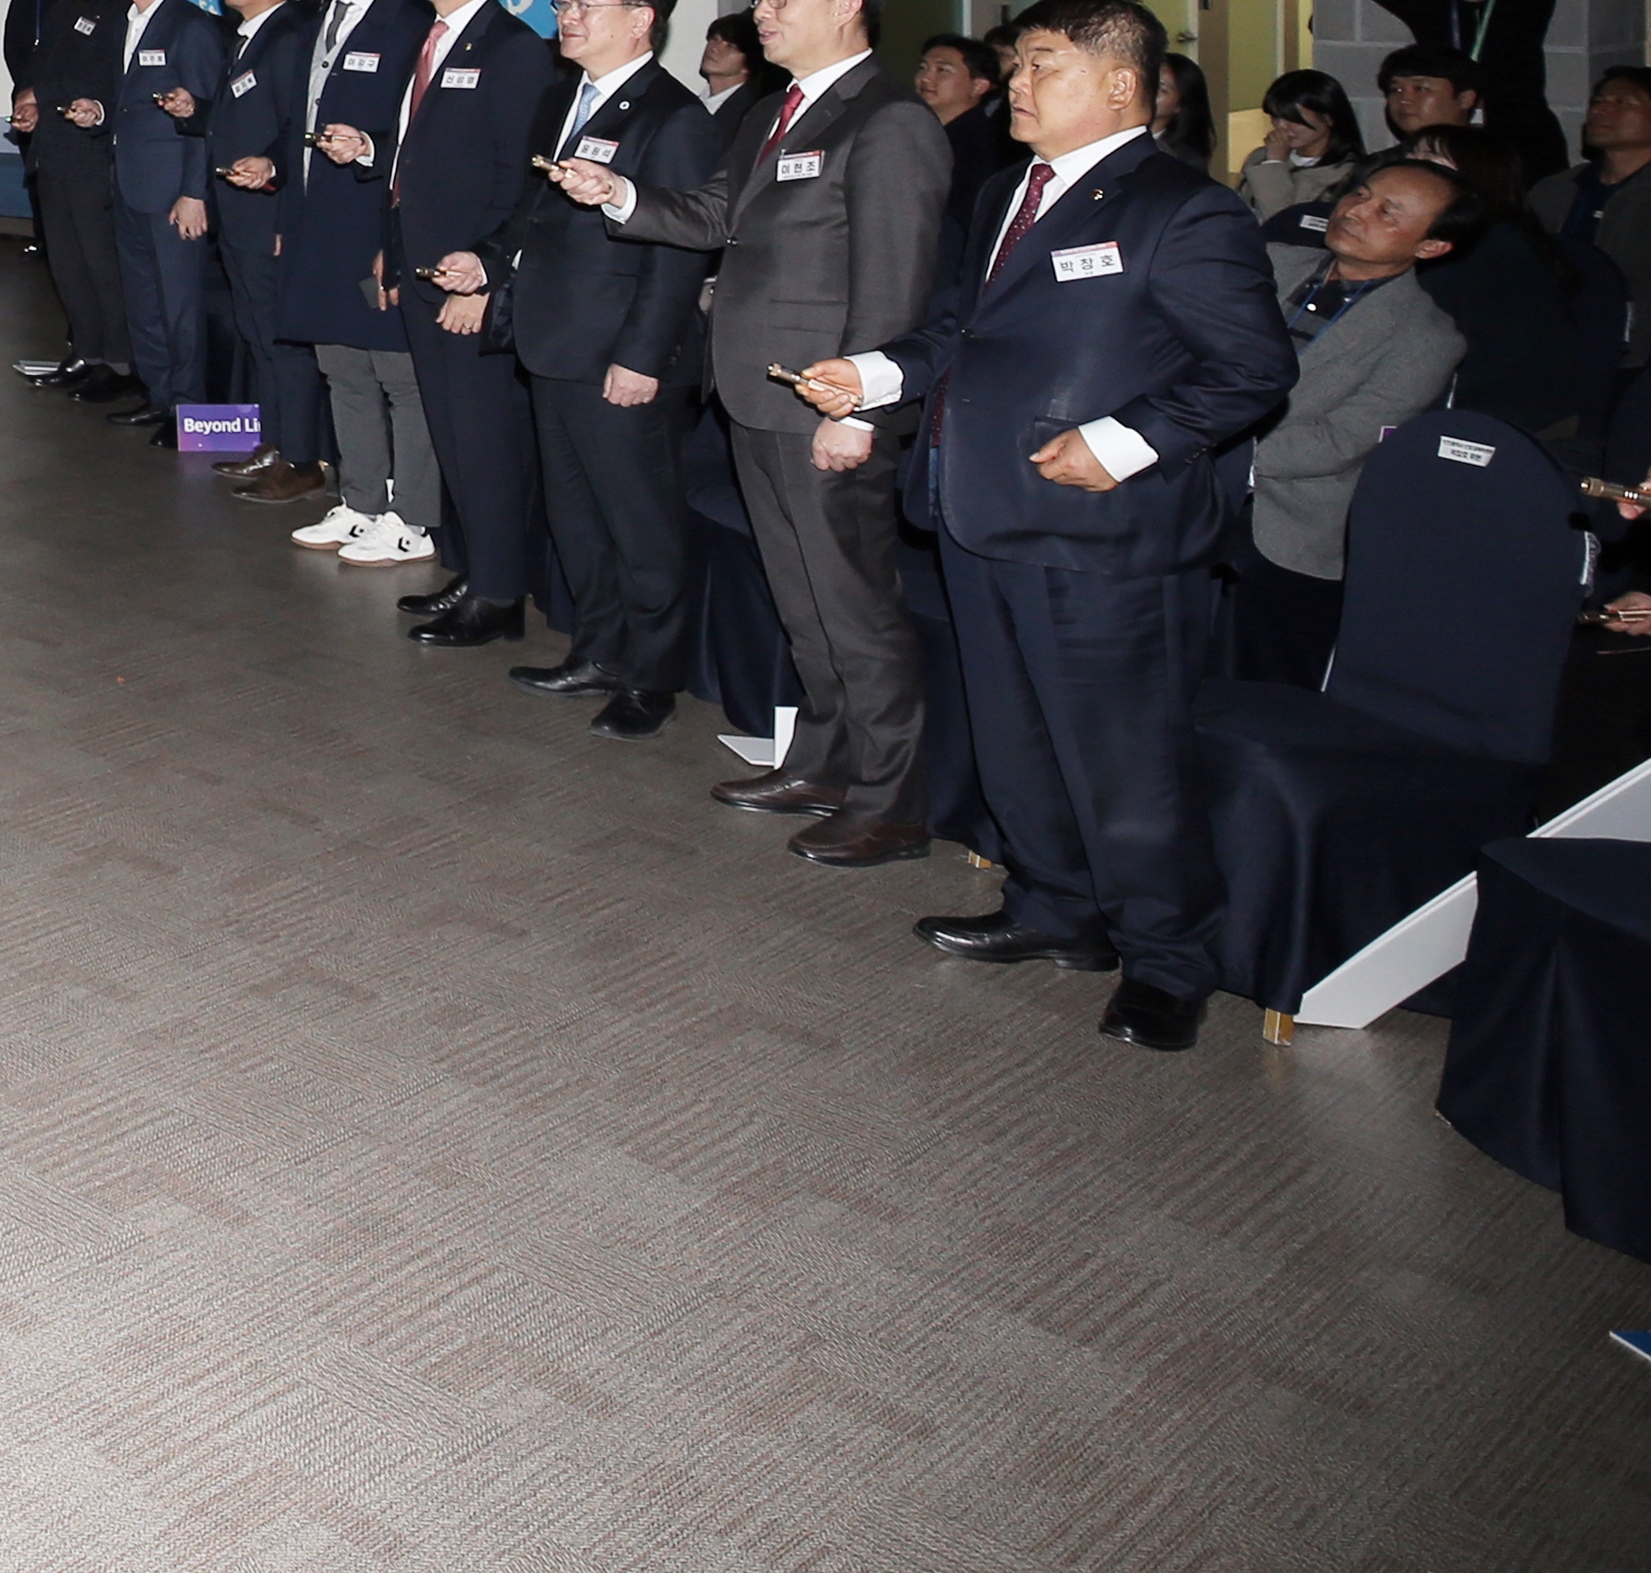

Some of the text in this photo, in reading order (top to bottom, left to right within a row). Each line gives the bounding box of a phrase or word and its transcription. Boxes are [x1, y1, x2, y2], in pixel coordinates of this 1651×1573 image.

[781, 160, 816, 175] 이현조
[1059, 254, 1115, 273] 박창호
[184, 417, 261, 435] Beyond Li
